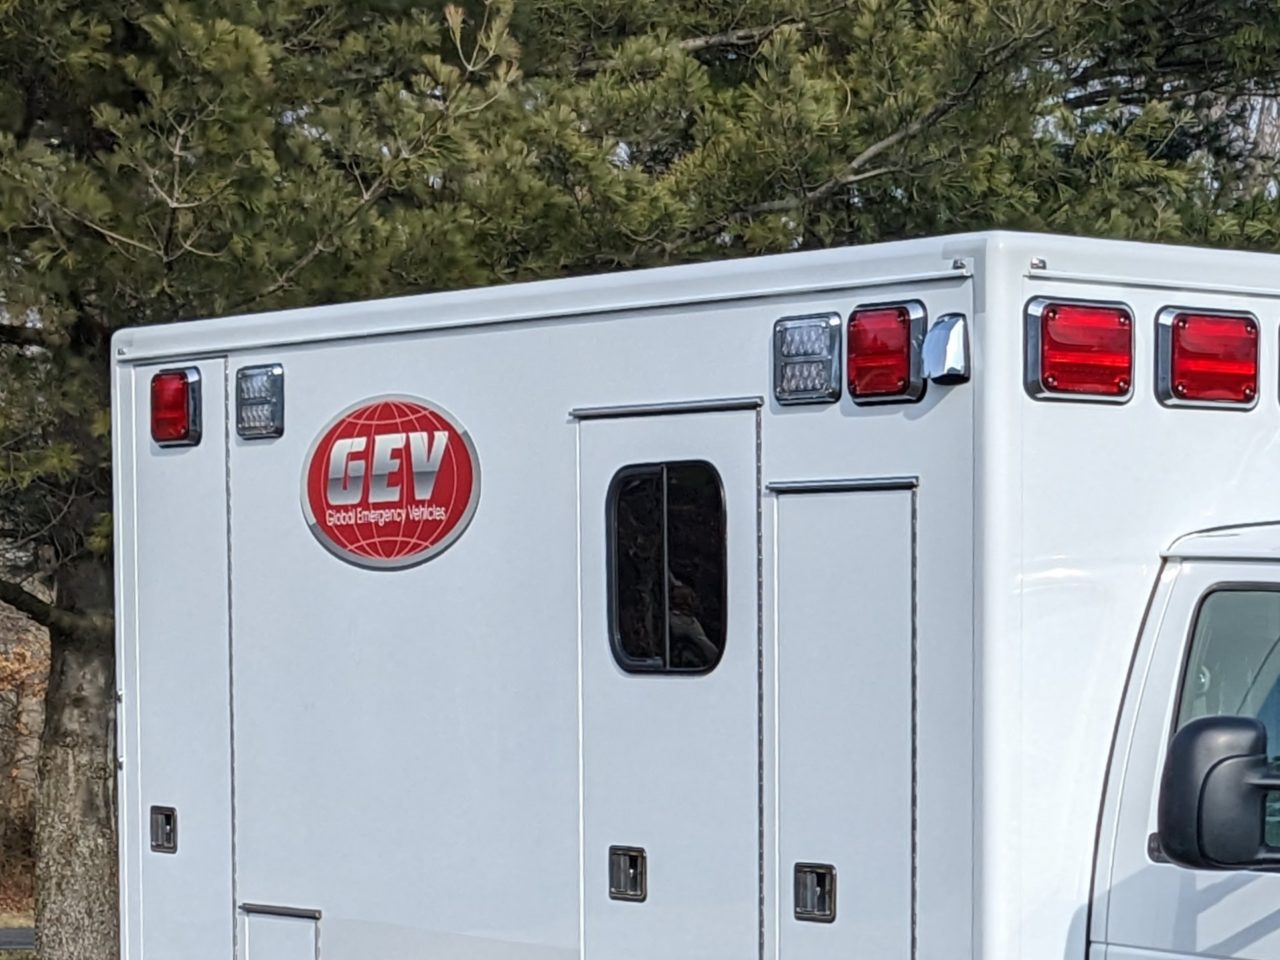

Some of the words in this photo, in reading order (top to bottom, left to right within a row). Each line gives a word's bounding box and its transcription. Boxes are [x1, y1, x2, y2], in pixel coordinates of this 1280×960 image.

[327, 431, 448, 505] GEV
[326, 508, 355, 526] Global
[357, 506, 406, 526] Emergency
[408, 504, 446, 521] Vehicles
